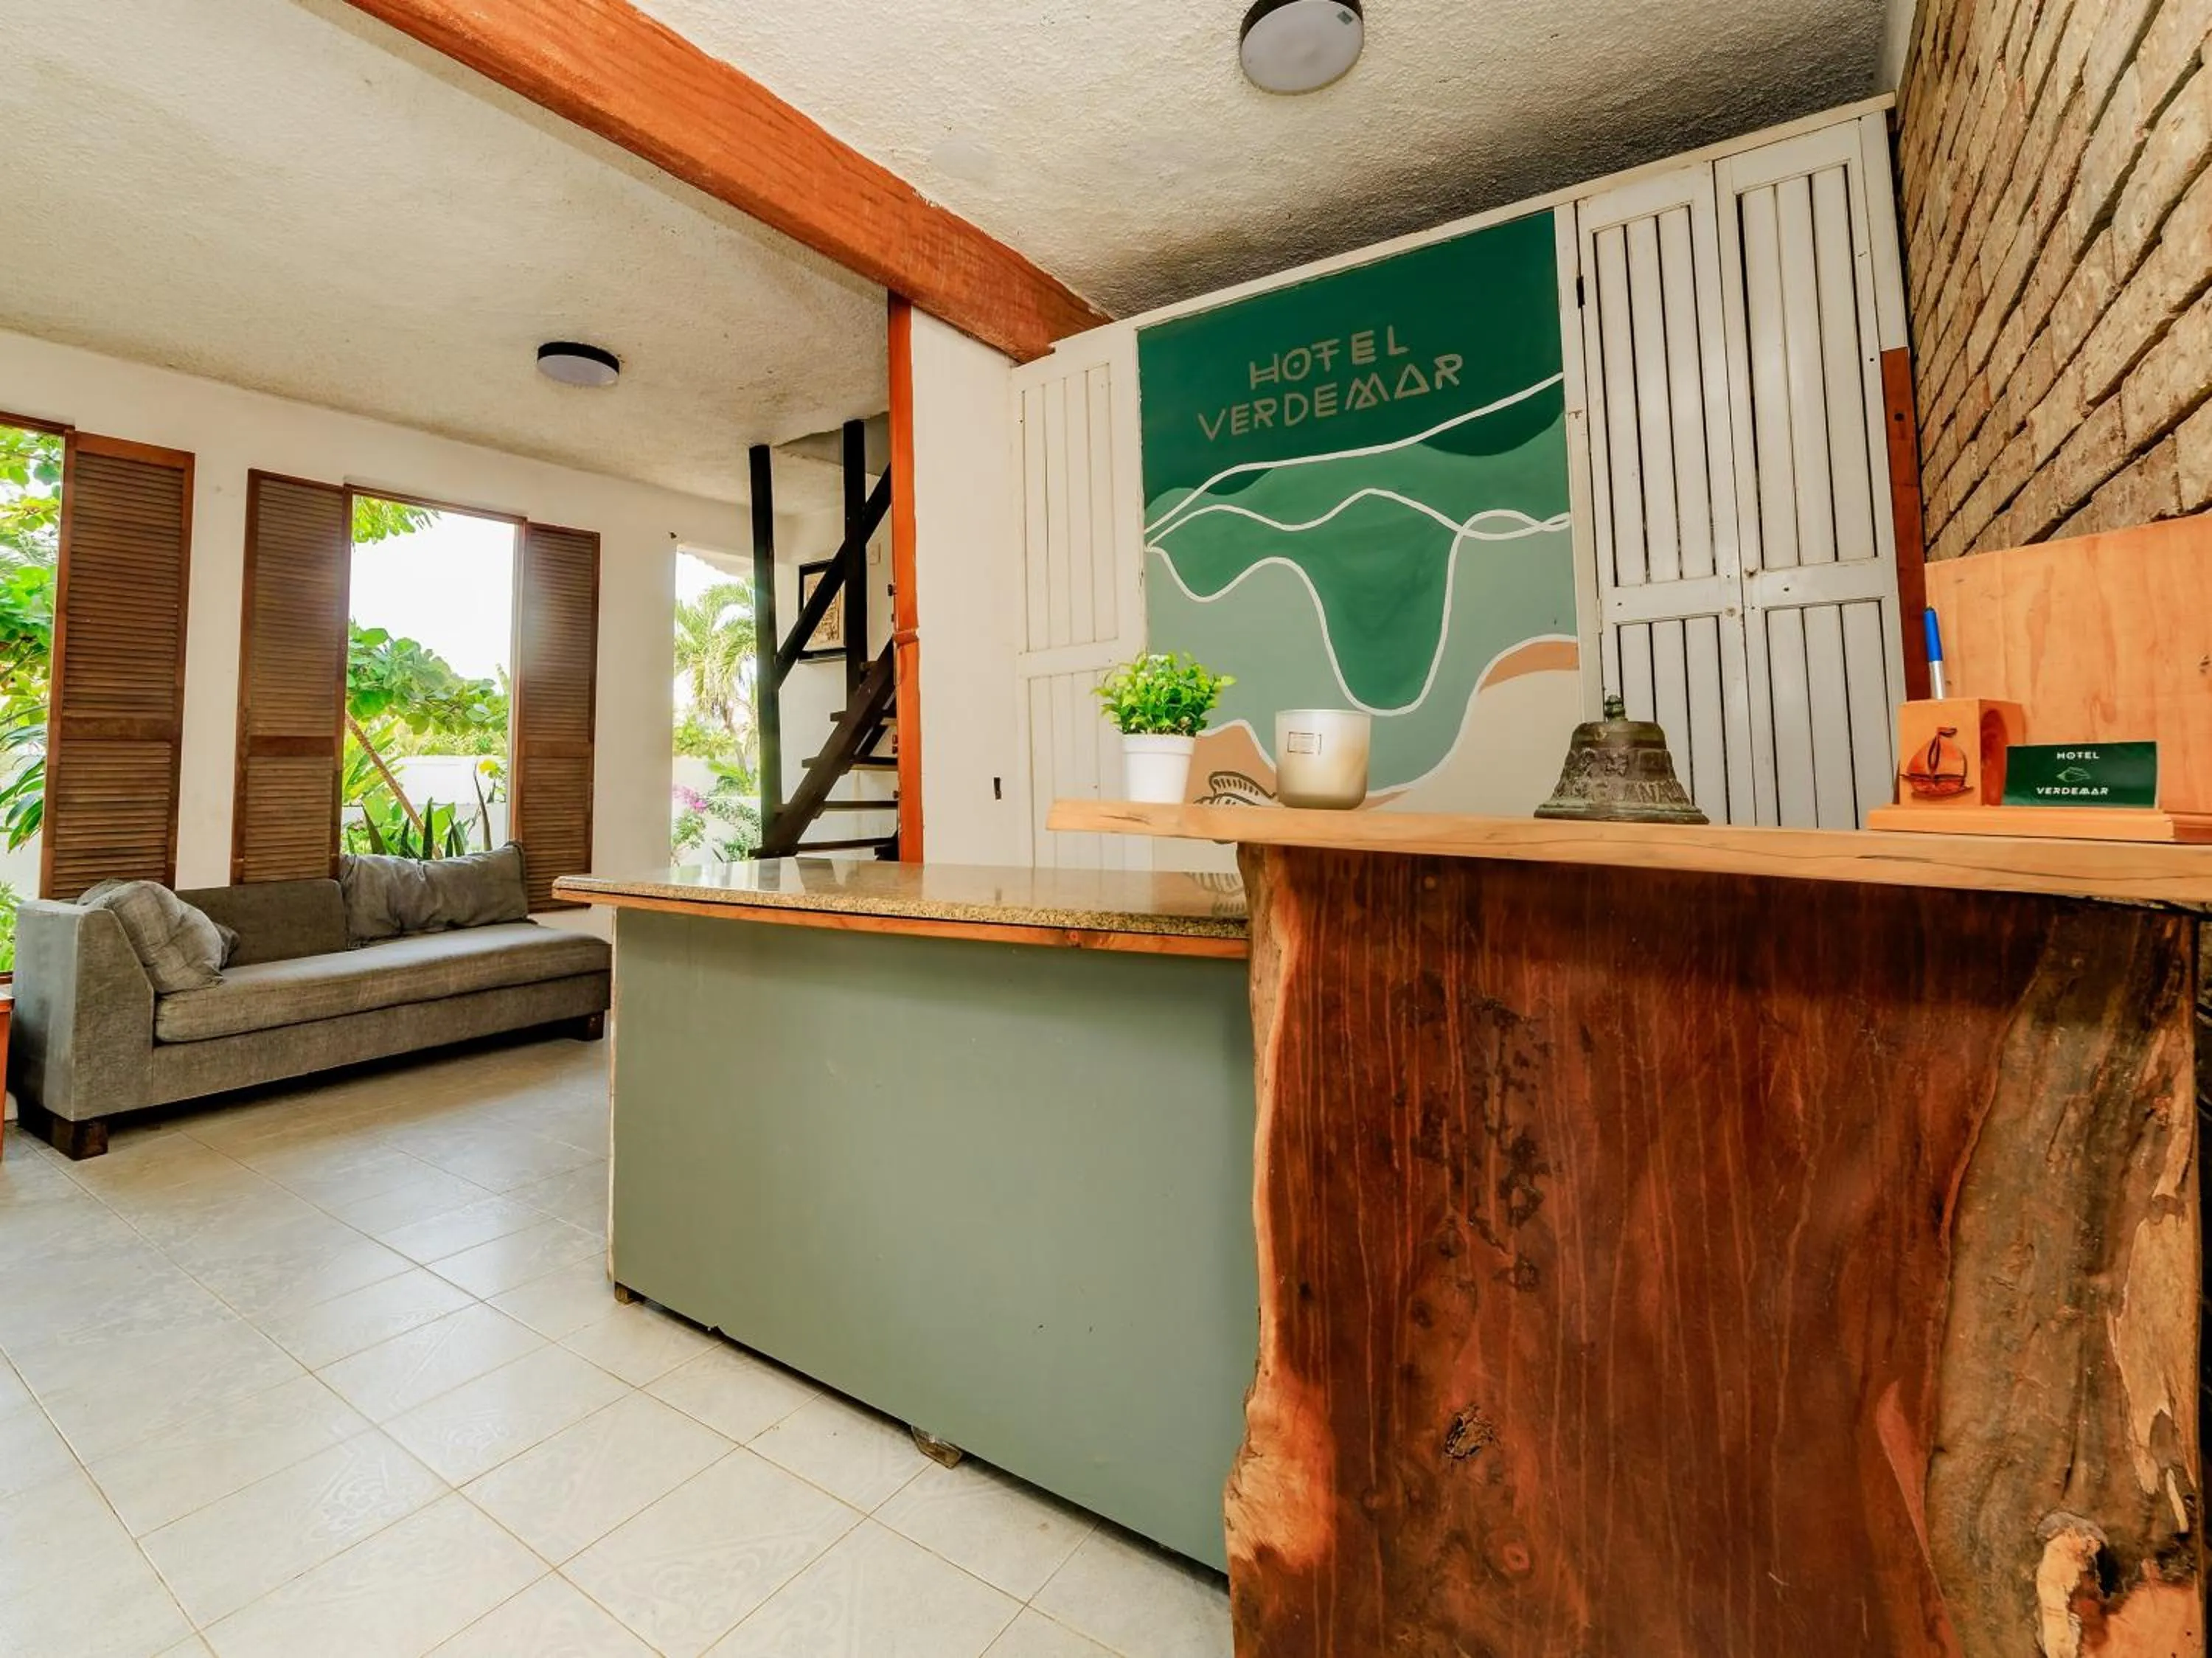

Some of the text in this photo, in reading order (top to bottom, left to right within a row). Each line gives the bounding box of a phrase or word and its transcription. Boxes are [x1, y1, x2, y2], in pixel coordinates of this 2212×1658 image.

[1249, 325, 1410, 390] HOTEL
[1197, 353, 1464, 441] VERDEMAR
[2056, 752, 2100, 760] HOTEL
[2036, 787, 2109, 795] VERDEMAR
